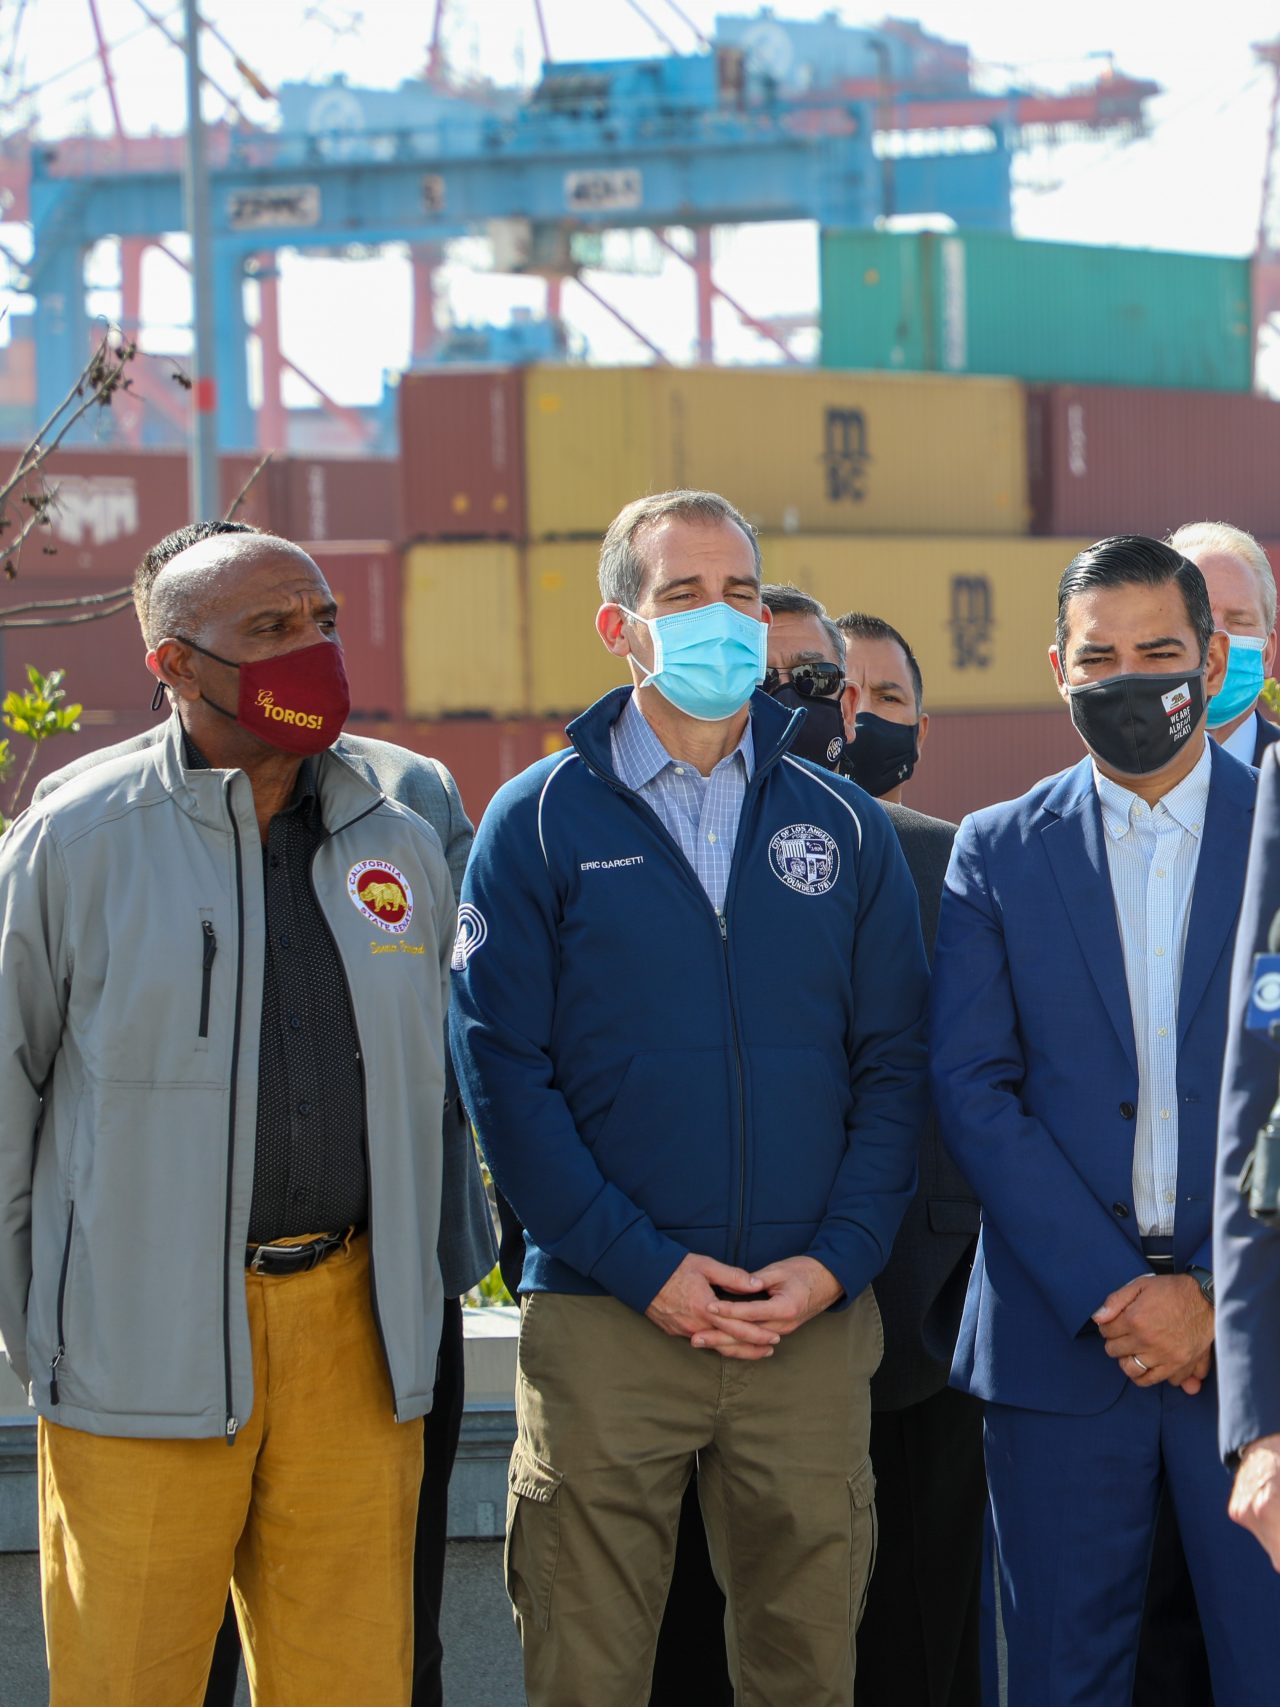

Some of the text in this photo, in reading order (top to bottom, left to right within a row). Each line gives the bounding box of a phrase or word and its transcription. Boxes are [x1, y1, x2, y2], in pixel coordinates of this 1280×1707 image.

[254, 689, 274, 706] Go
[263, 703, 324, 730] TOROS!
[1170, 712, 1180, 724] WE
[771, 835, 782, 850] CITY
[781, 829, 790, 839] OF
[791, 826, 806, 834] LOS
[807, 826, 836, 851] ANGELES
[348, 860, 401, 886] CALIFORNIA
[580, 855, 644, 871] ERIC GARCETTI
[782, 874, 832, 893] FOUNDED 1781
[360, 904, 413, 933] STATE SENATE
